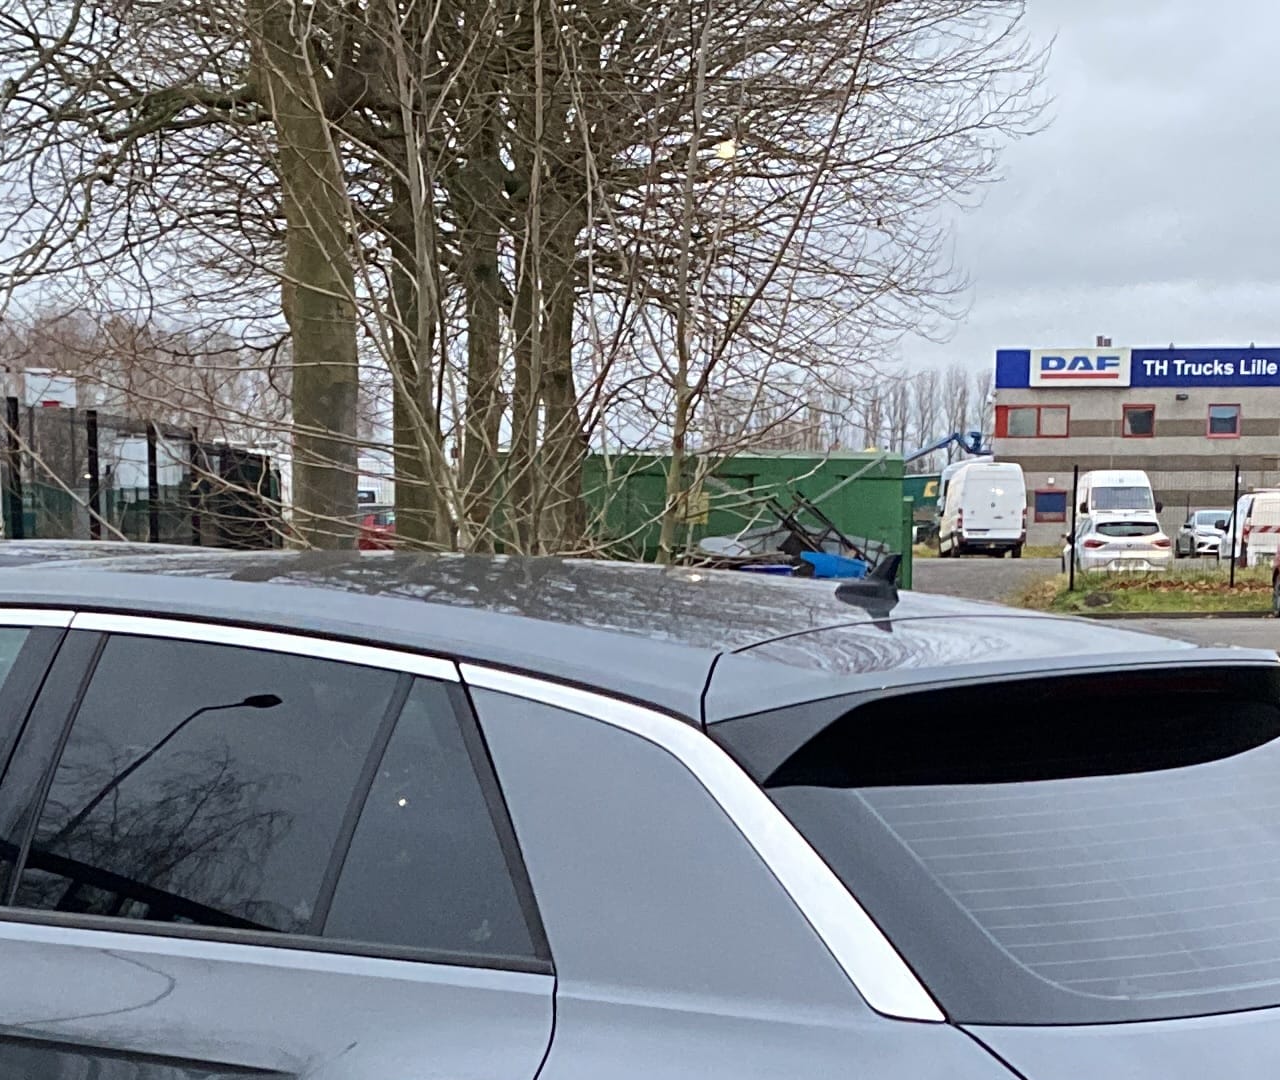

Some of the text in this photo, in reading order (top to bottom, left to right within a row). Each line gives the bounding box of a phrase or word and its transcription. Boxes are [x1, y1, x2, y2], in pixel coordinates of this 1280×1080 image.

[1040, 356, 1120, 371] DAF
[1143, 359, 1278, 376] TH Trucks Lille
